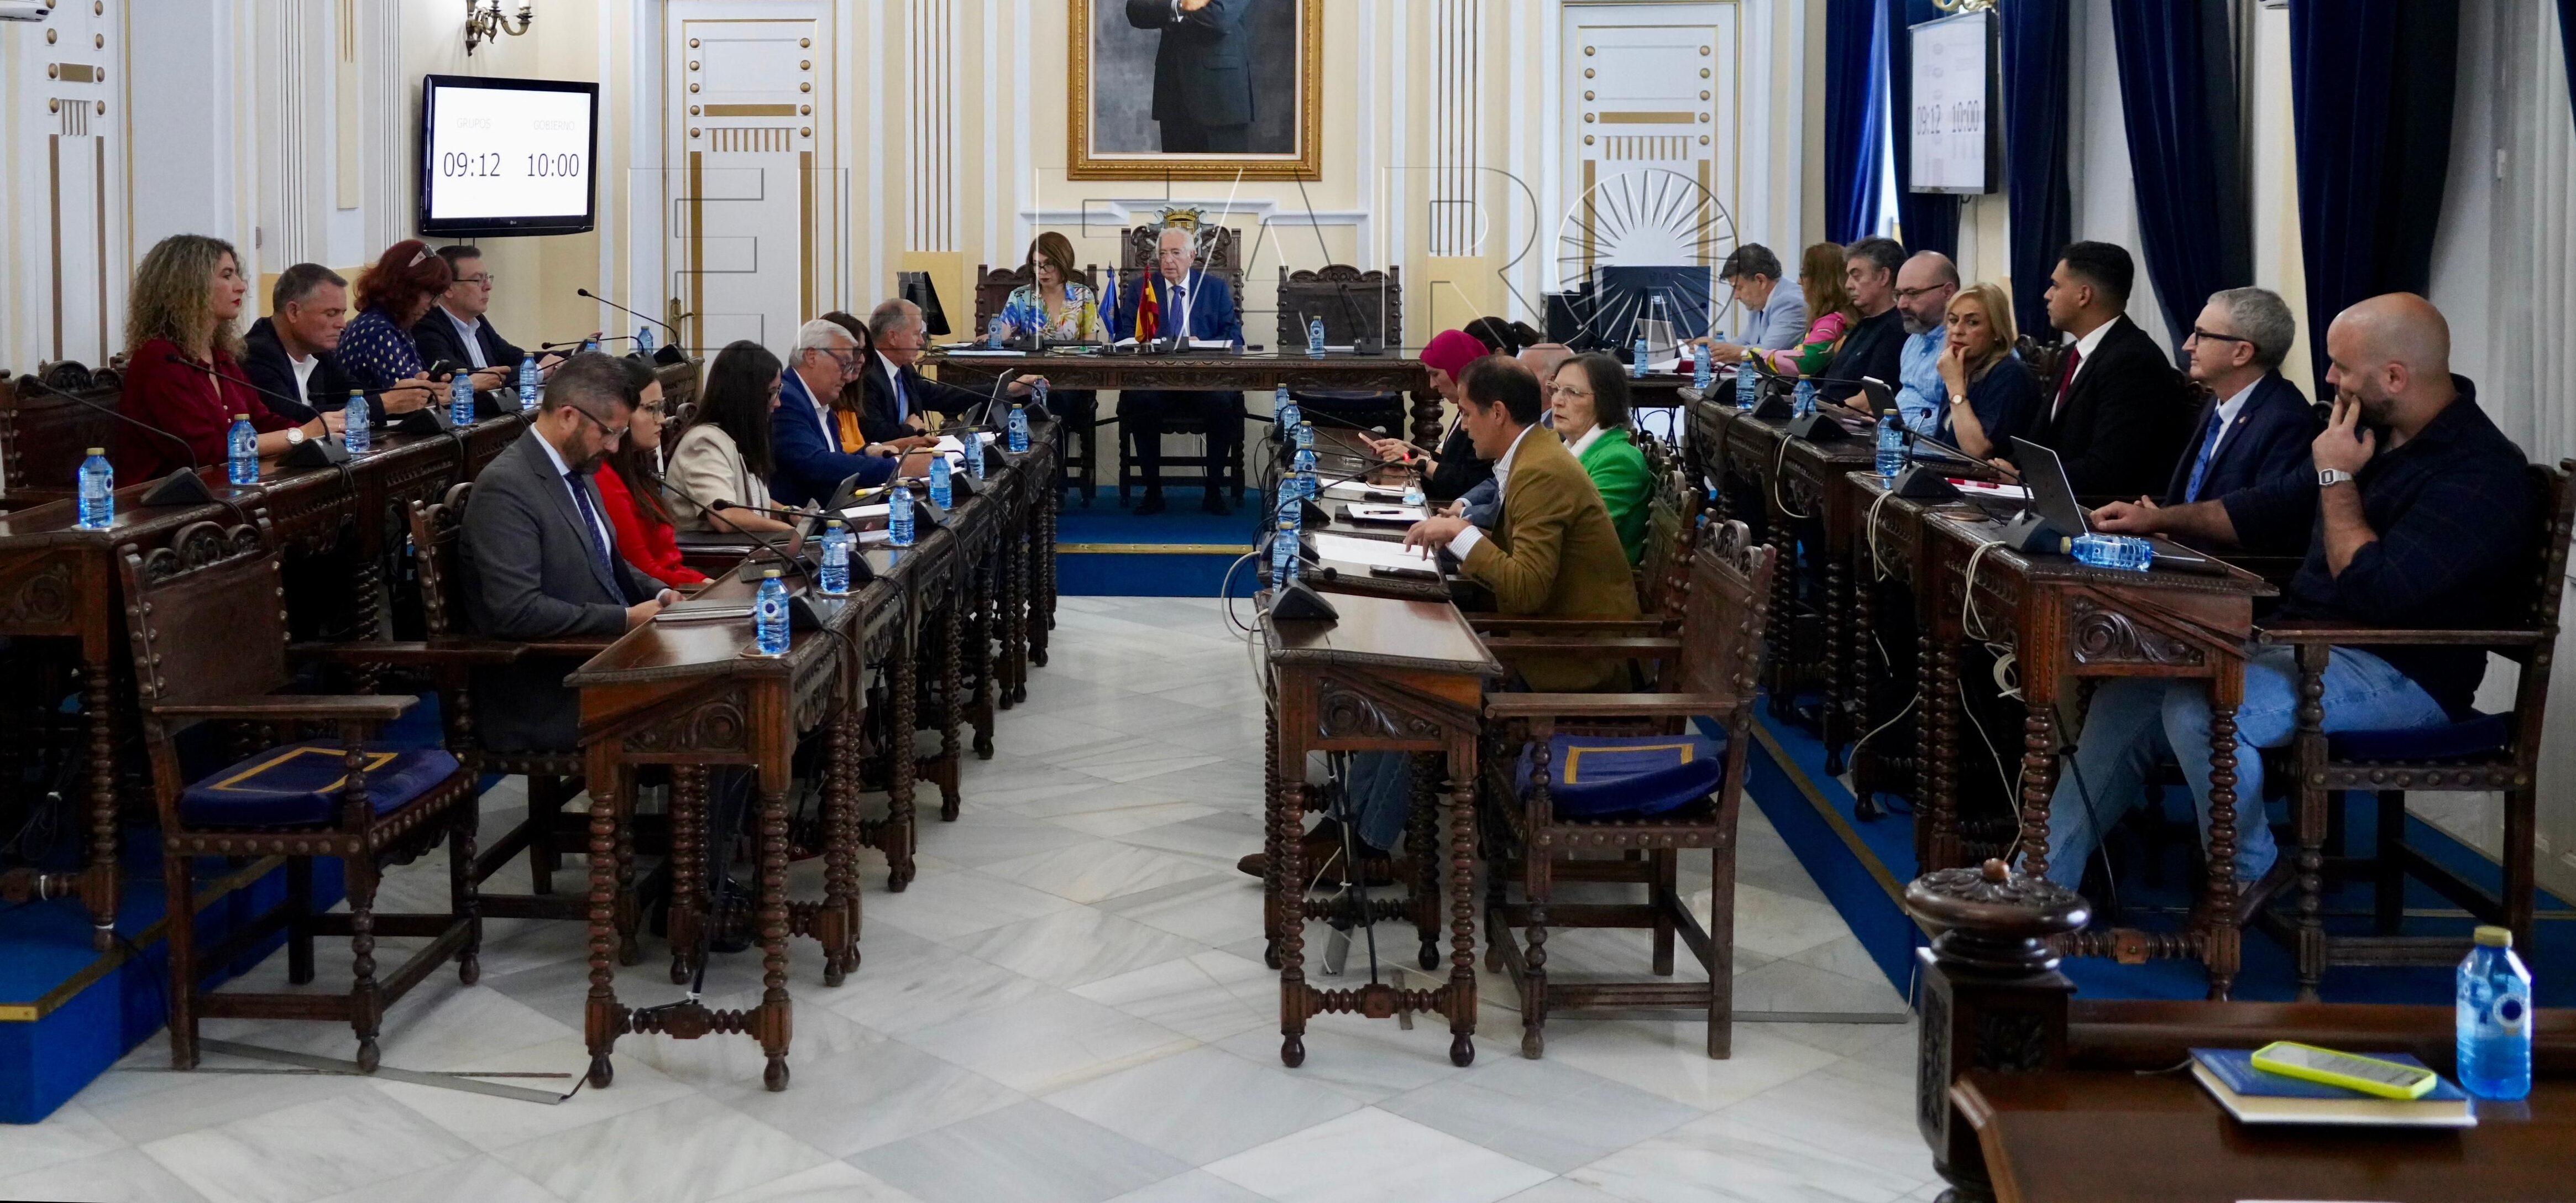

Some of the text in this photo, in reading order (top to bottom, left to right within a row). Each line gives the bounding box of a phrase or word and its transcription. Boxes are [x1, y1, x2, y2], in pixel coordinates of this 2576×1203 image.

[456, 118, 575, 130] GRUPOS GOBIERNO
[1917, 100, 1980, 135] 09:12 10:00
[443, 152, 579, 177] 09:12 10:00
